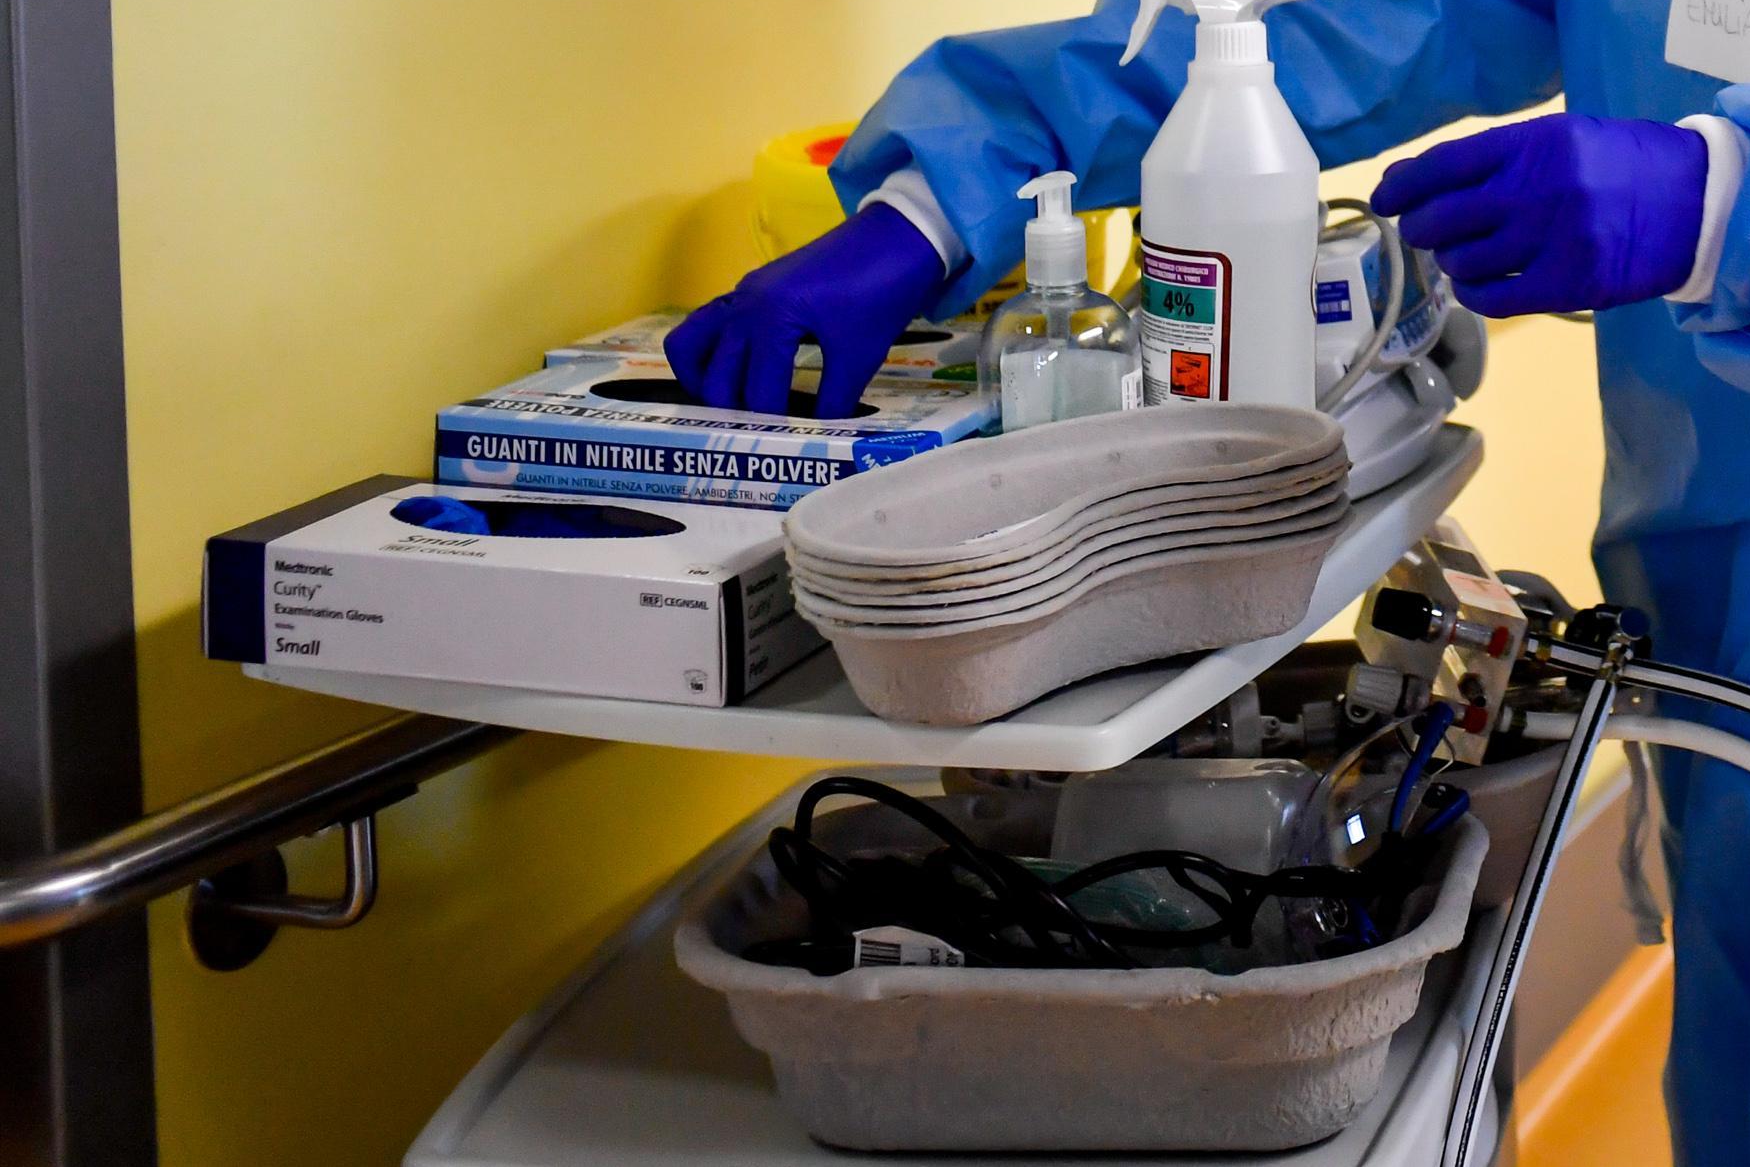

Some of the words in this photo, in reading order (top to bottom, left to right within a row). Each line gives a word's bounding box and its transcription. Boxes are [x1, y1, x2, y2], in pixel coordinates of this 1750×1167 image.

[1163, 289, 1195, 317] 4%
[485, 399, 577, 416] POLVERE
[467, 435, 546, 463] GUANTI
[555, 442, 577, 466] IN
[586, 444, 665, 473] NITRILE
[673, 450, 740, 478] SENZA
[747, 456, 841, 484] POLVERE
[515, 472, 555, 485] GUANTI
[557, 475, 569, 486] IN
[572, 477, 607, 490] NITRILE
[609, 479, 643, 492] SENZA
[759, 491, 786, 503] NON
[398, 534, 480, 547] Small
[274, 560, 334, 577] Medtronic
[641, 594, 661, 607] REF
[274, 603, 344, 620] Examination
[345, 609, 385, 624] Gloves
[275, 637, 321, 656] Small
